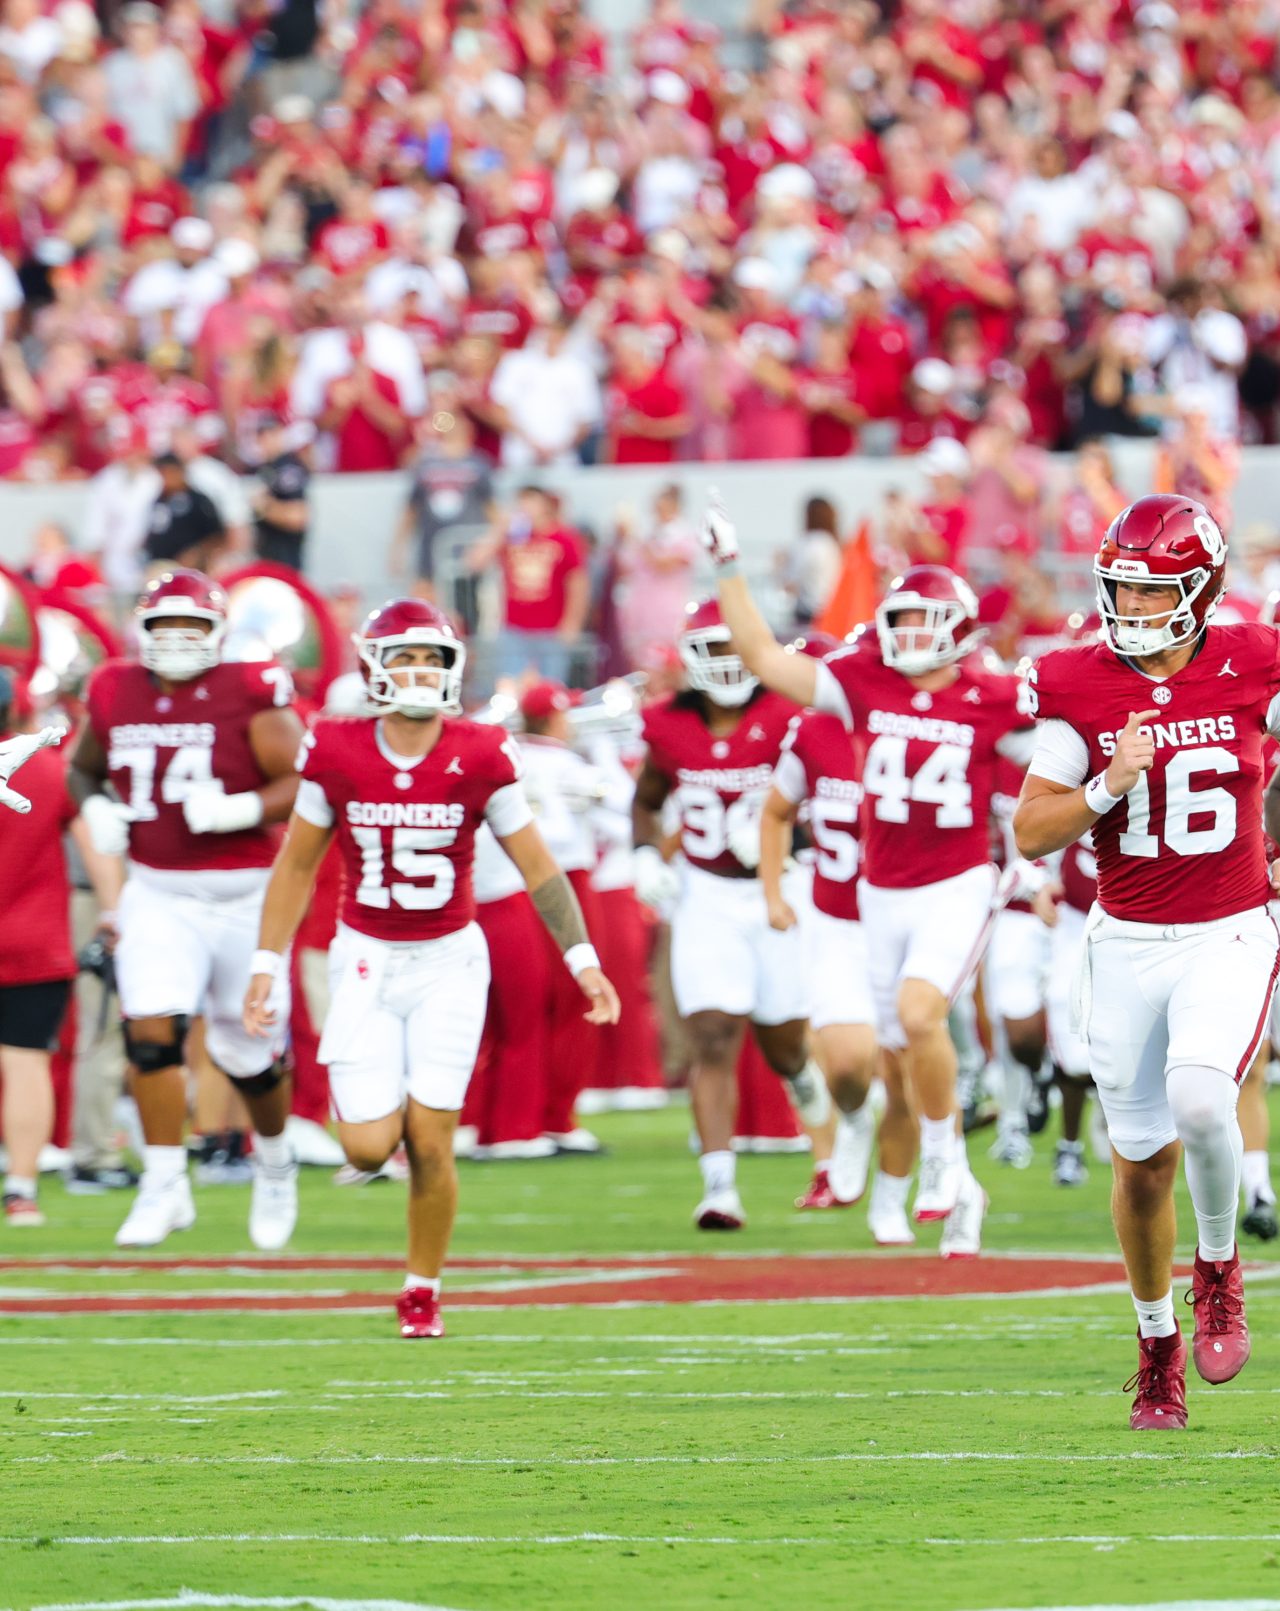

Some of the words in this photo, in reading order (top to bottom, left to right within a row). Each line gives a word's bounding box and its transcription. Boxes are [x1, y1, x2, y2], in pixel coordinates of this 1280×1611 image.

[109, 746, 218, 821] 74
[346, 800, 465, 827] SOONERS
[863, 735, 973, 828] 44
[1119, 746, 1240, 858] 16
[351, 827, 457, 910] 15
